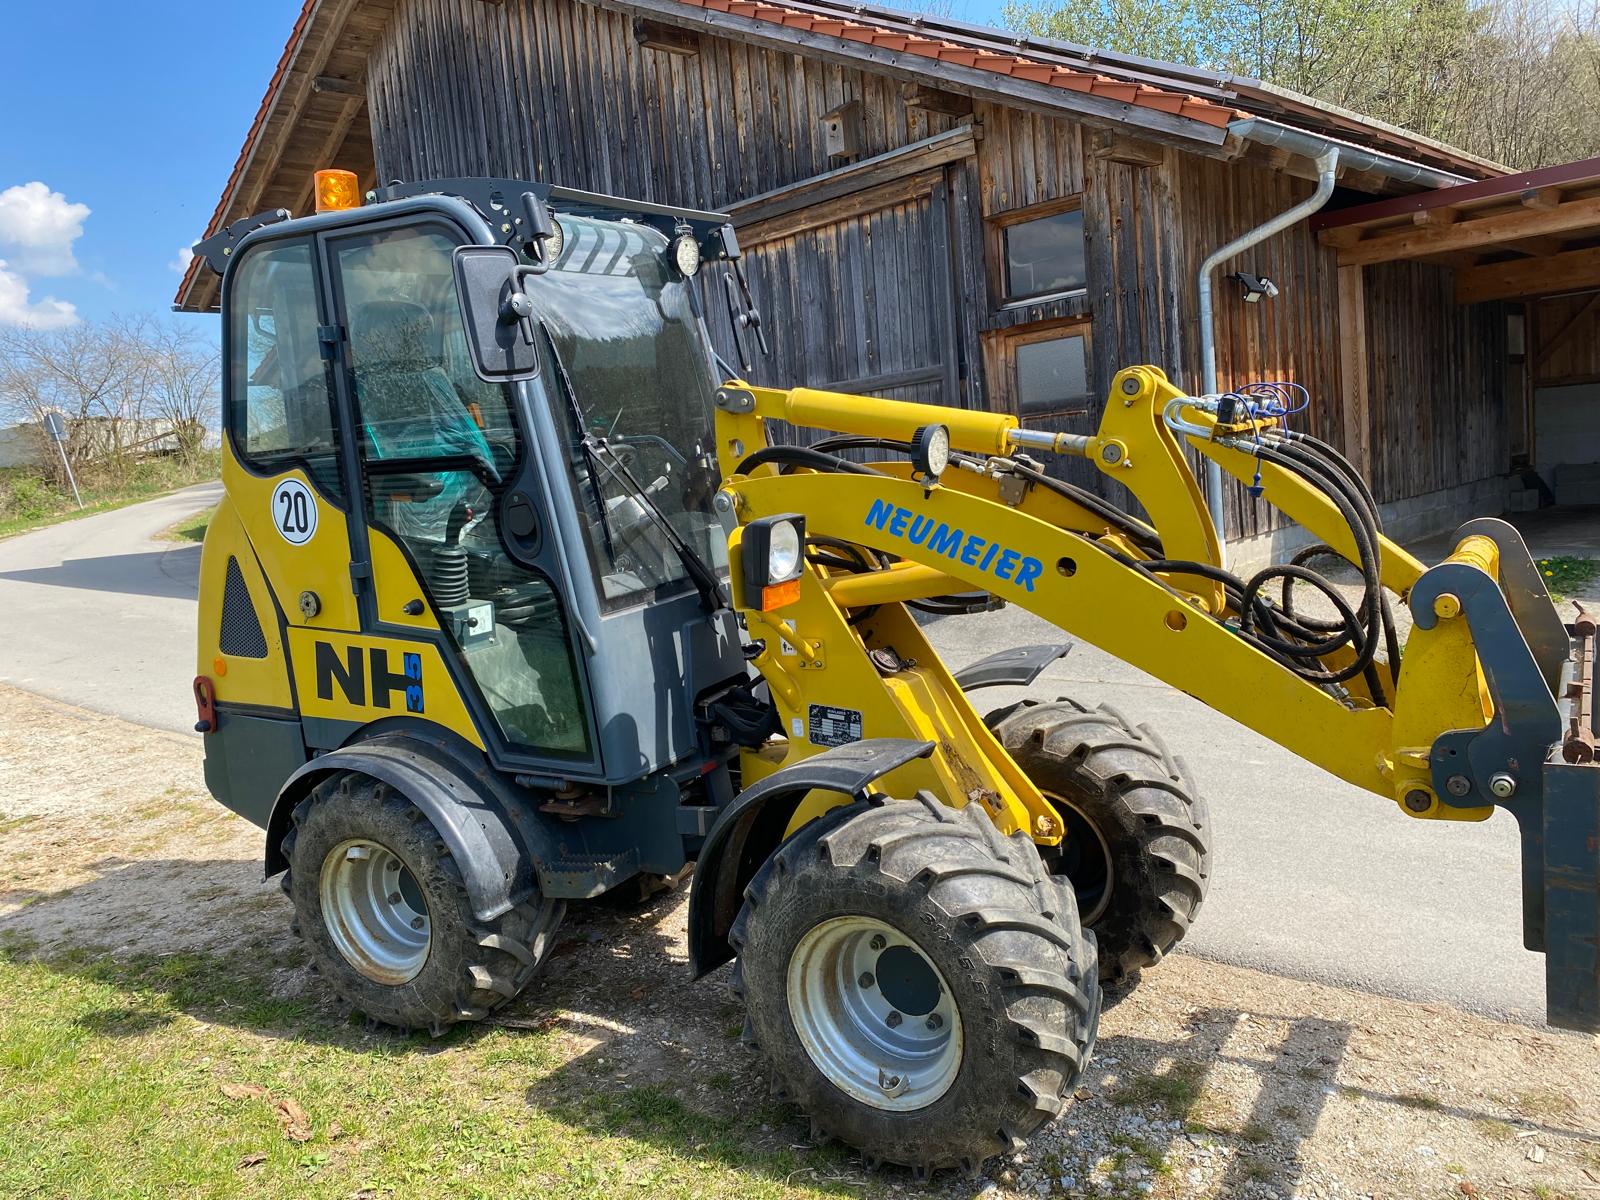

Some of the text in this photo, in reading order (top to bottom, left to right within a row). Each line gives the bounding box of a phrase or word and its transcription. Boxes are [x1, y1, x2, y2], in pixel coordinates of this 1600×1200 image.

[279, 491, 309, 534] 20
[865, 498, 1044, 593] NEUMEIER
[315, 641, 425, 714] NH
